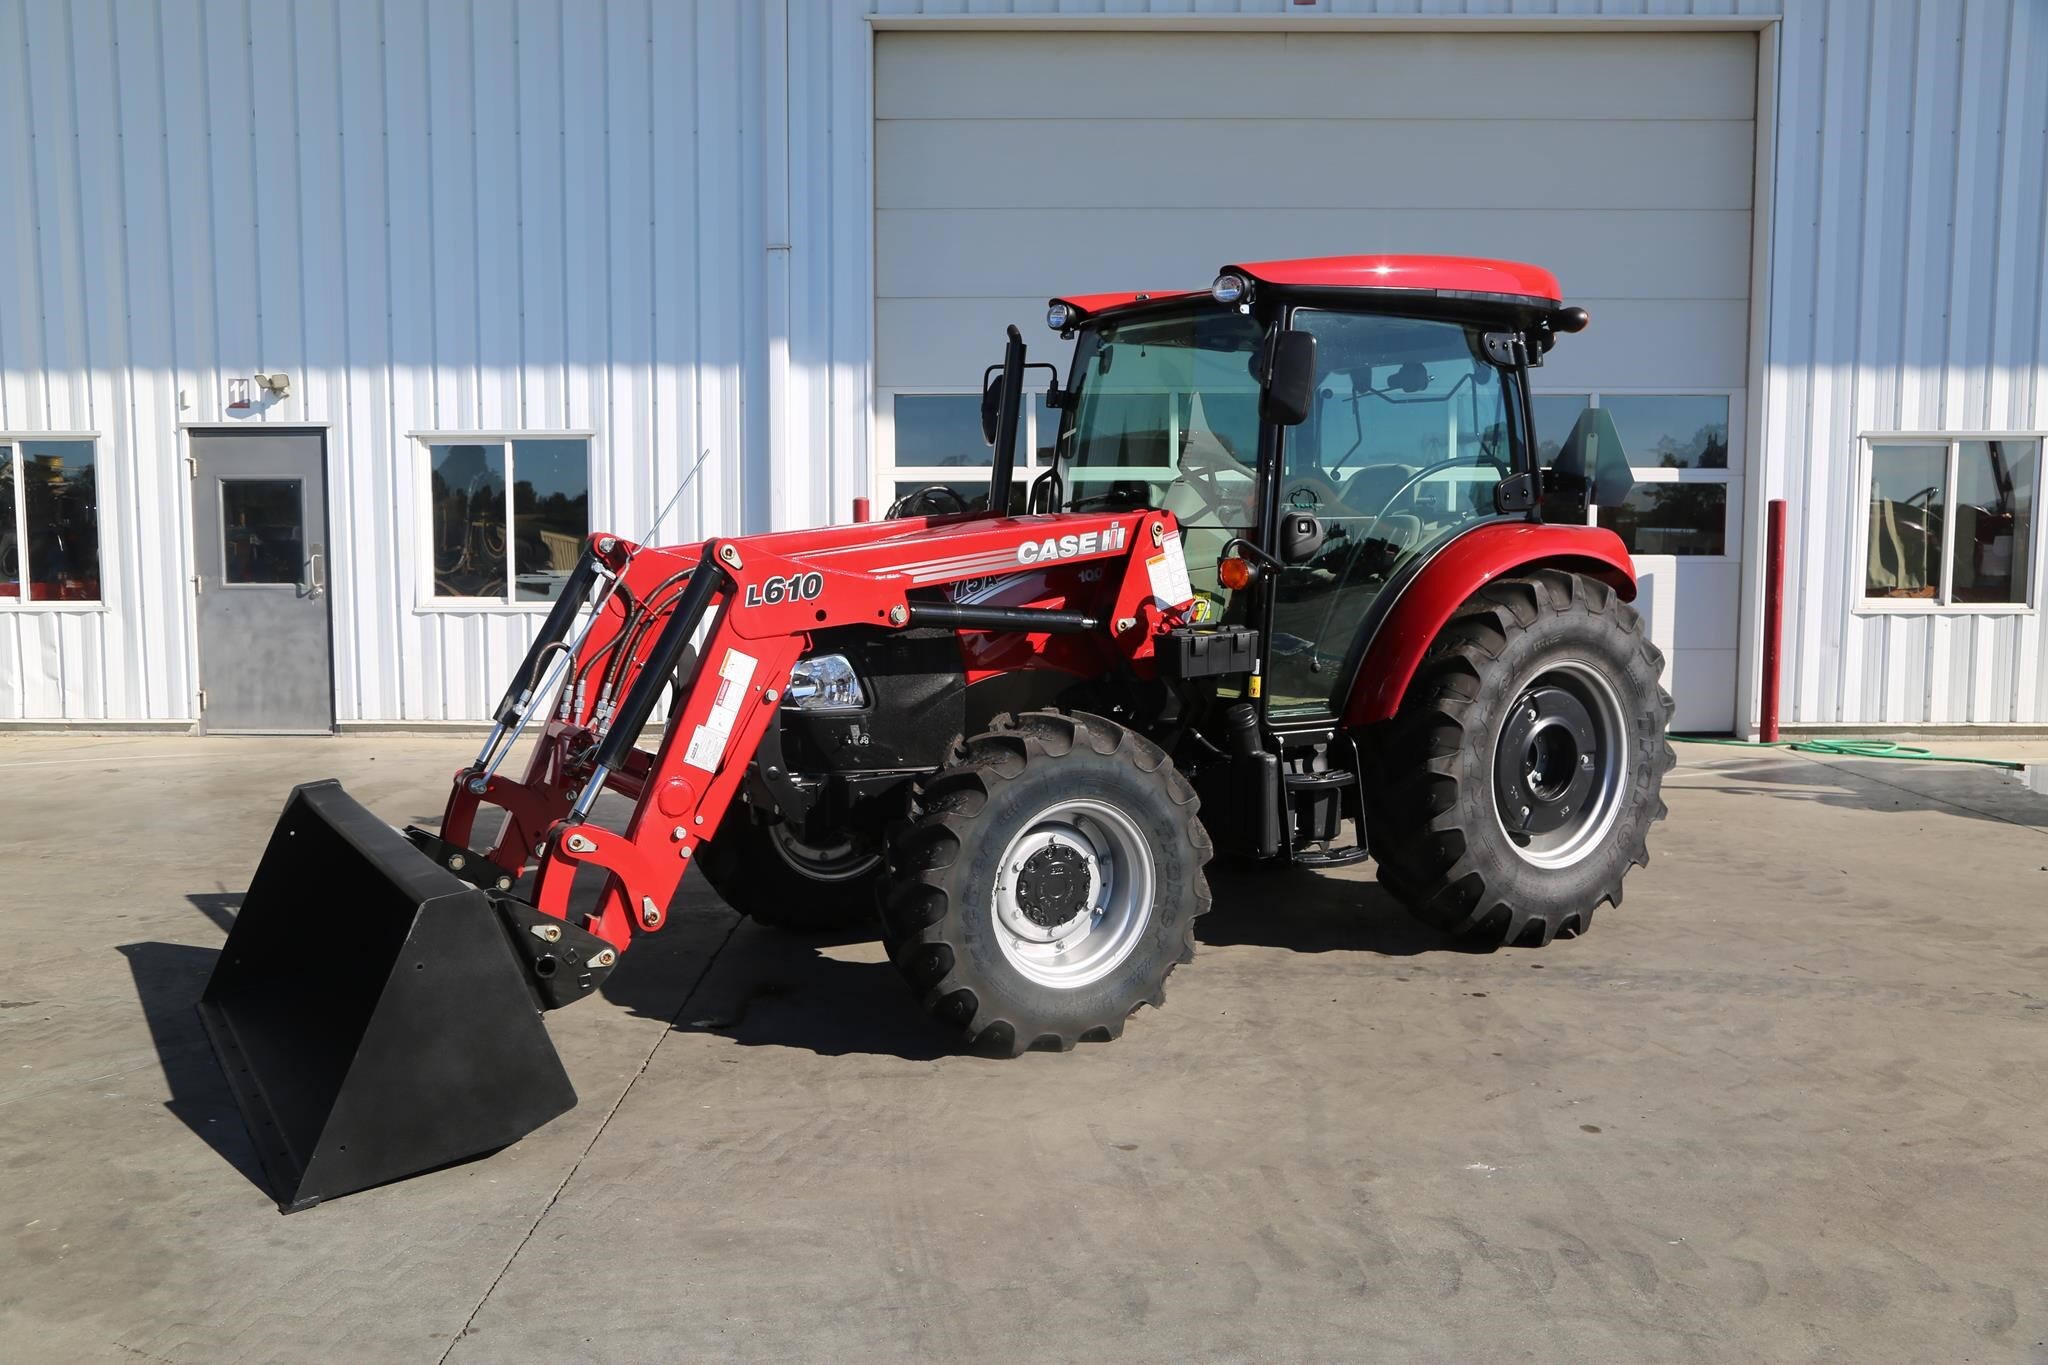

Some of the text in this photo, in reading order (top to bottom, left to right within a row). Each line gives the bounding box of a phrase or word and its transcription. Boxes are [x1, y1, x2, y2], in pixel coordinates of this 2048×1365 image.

[230, 380, 249, 404] 11
[1017, 531, 1098, 564] CASE
[745, 571, 824, 608] L610
